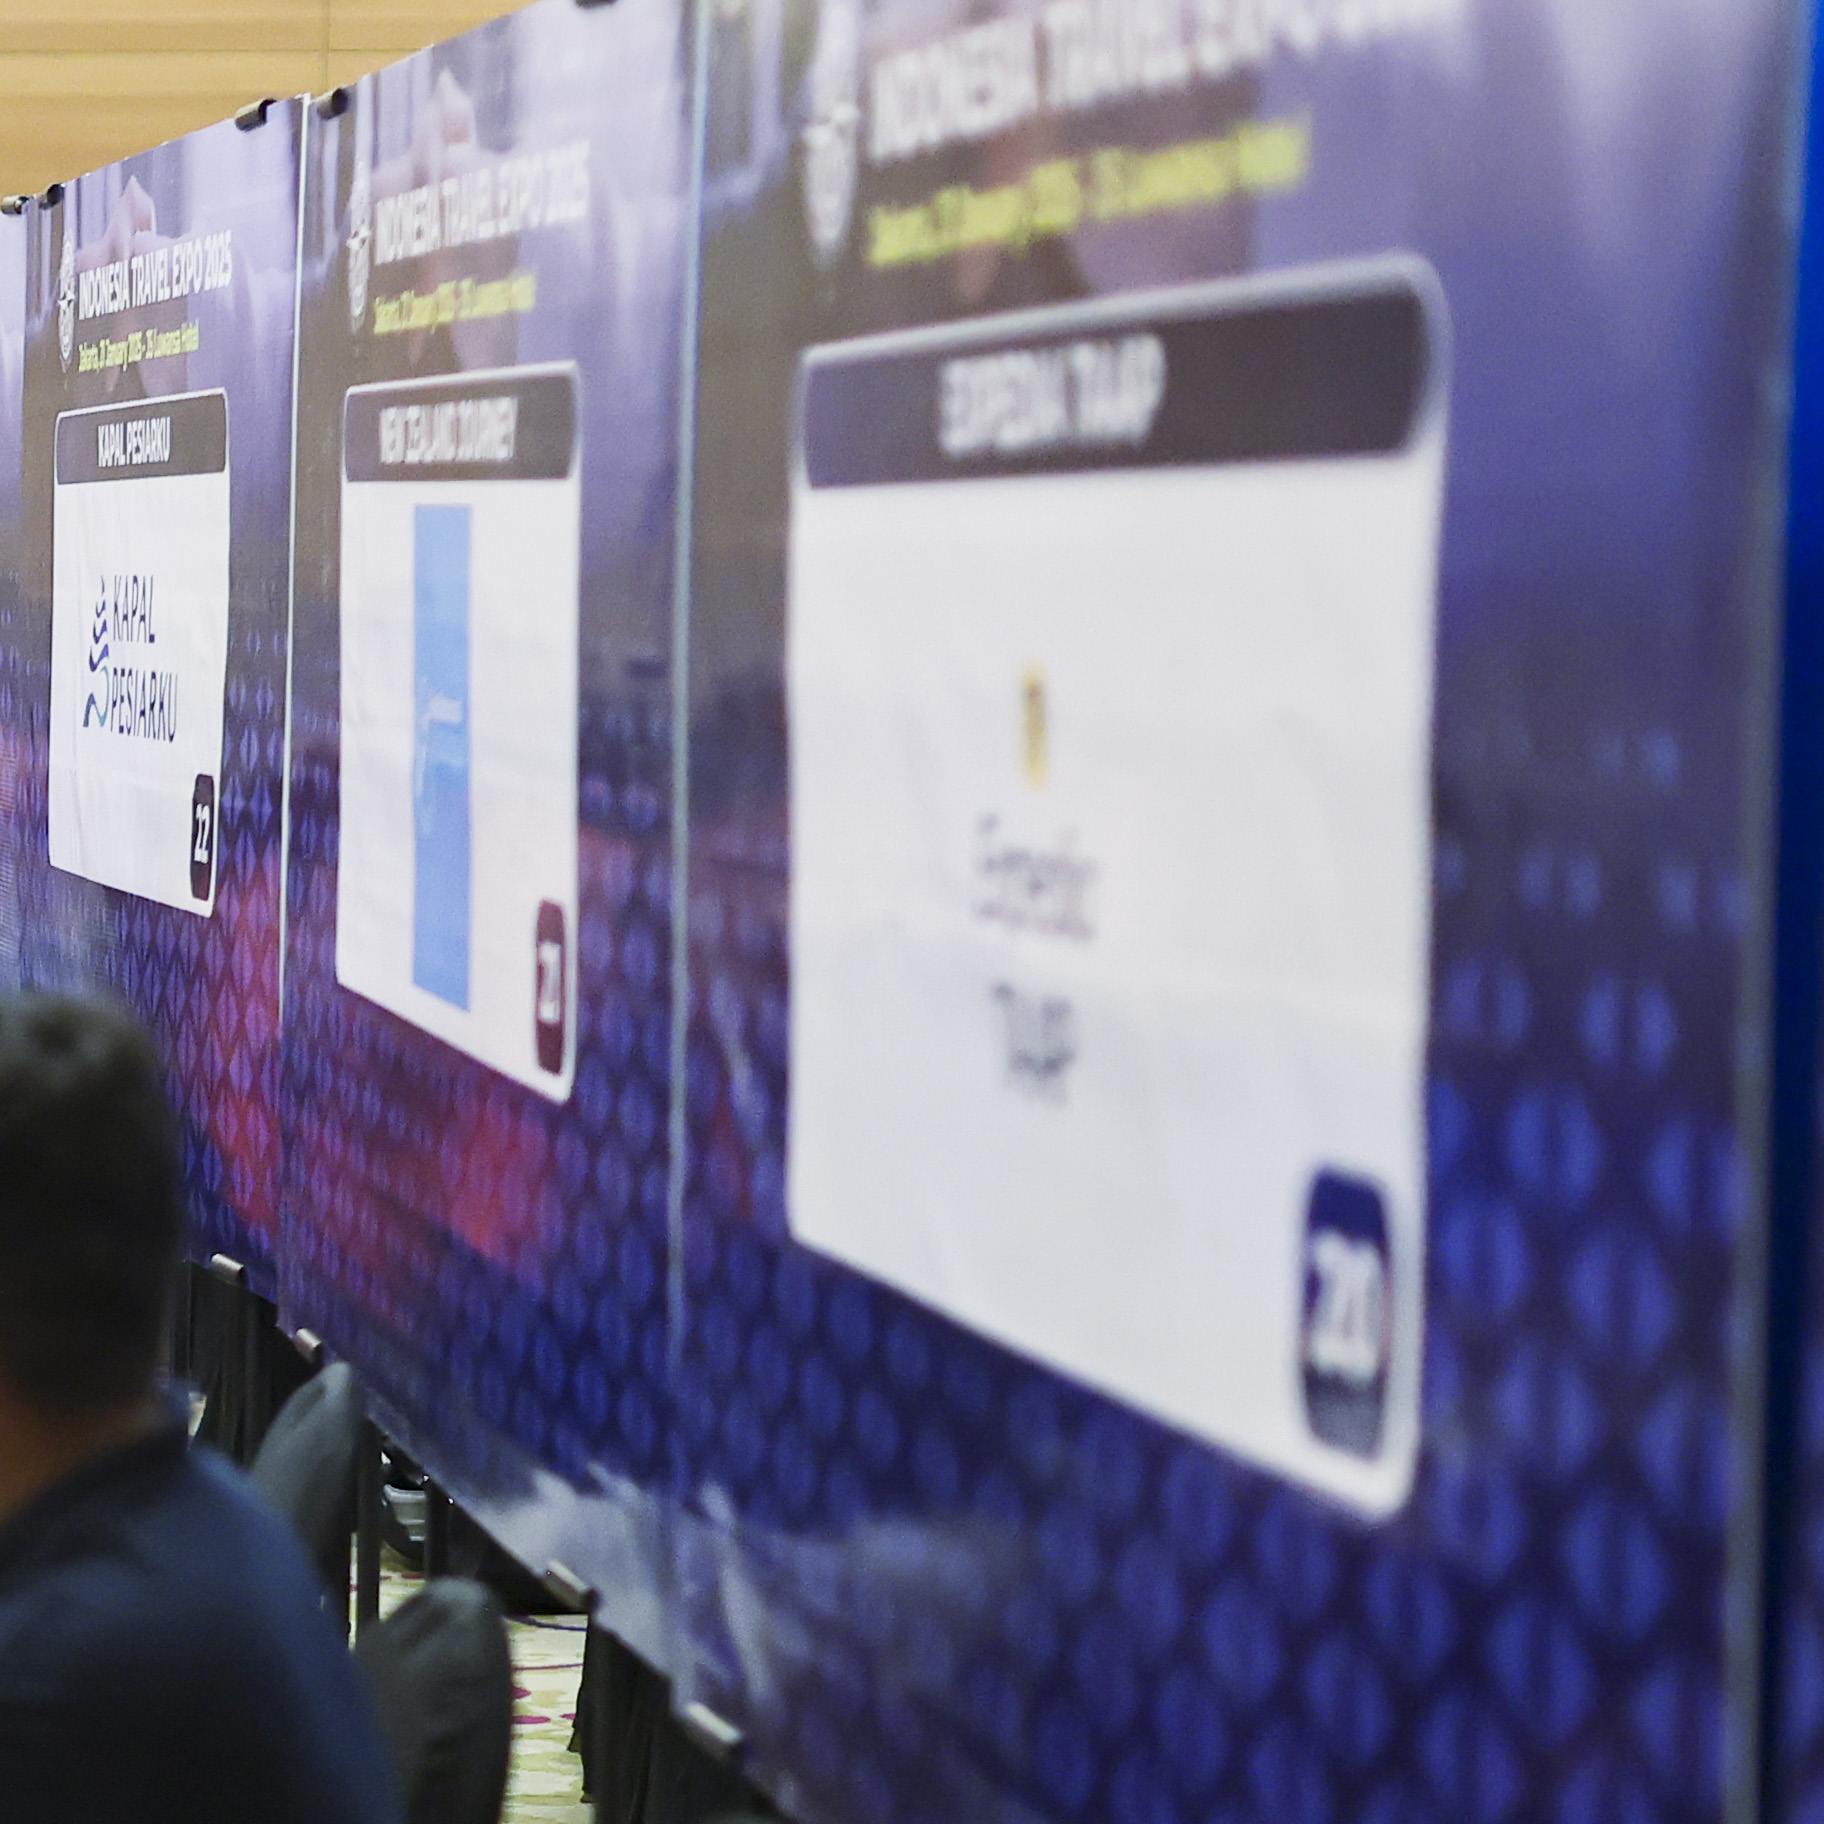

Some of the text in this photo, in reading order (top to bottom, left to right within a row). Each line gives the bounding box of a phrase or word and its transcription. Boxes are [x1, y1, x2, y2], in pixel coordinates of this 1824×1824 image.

[78, 229, 232, 320] INDONESIA TRAVEL EXPO 2025
[98, 417, 171, 467] KAPAL PESIARKU
[113, 574, 155, 643] KAPAL
[111, 667, 179, 742] PESIARKU
[194, 803, 211, 864] 22
